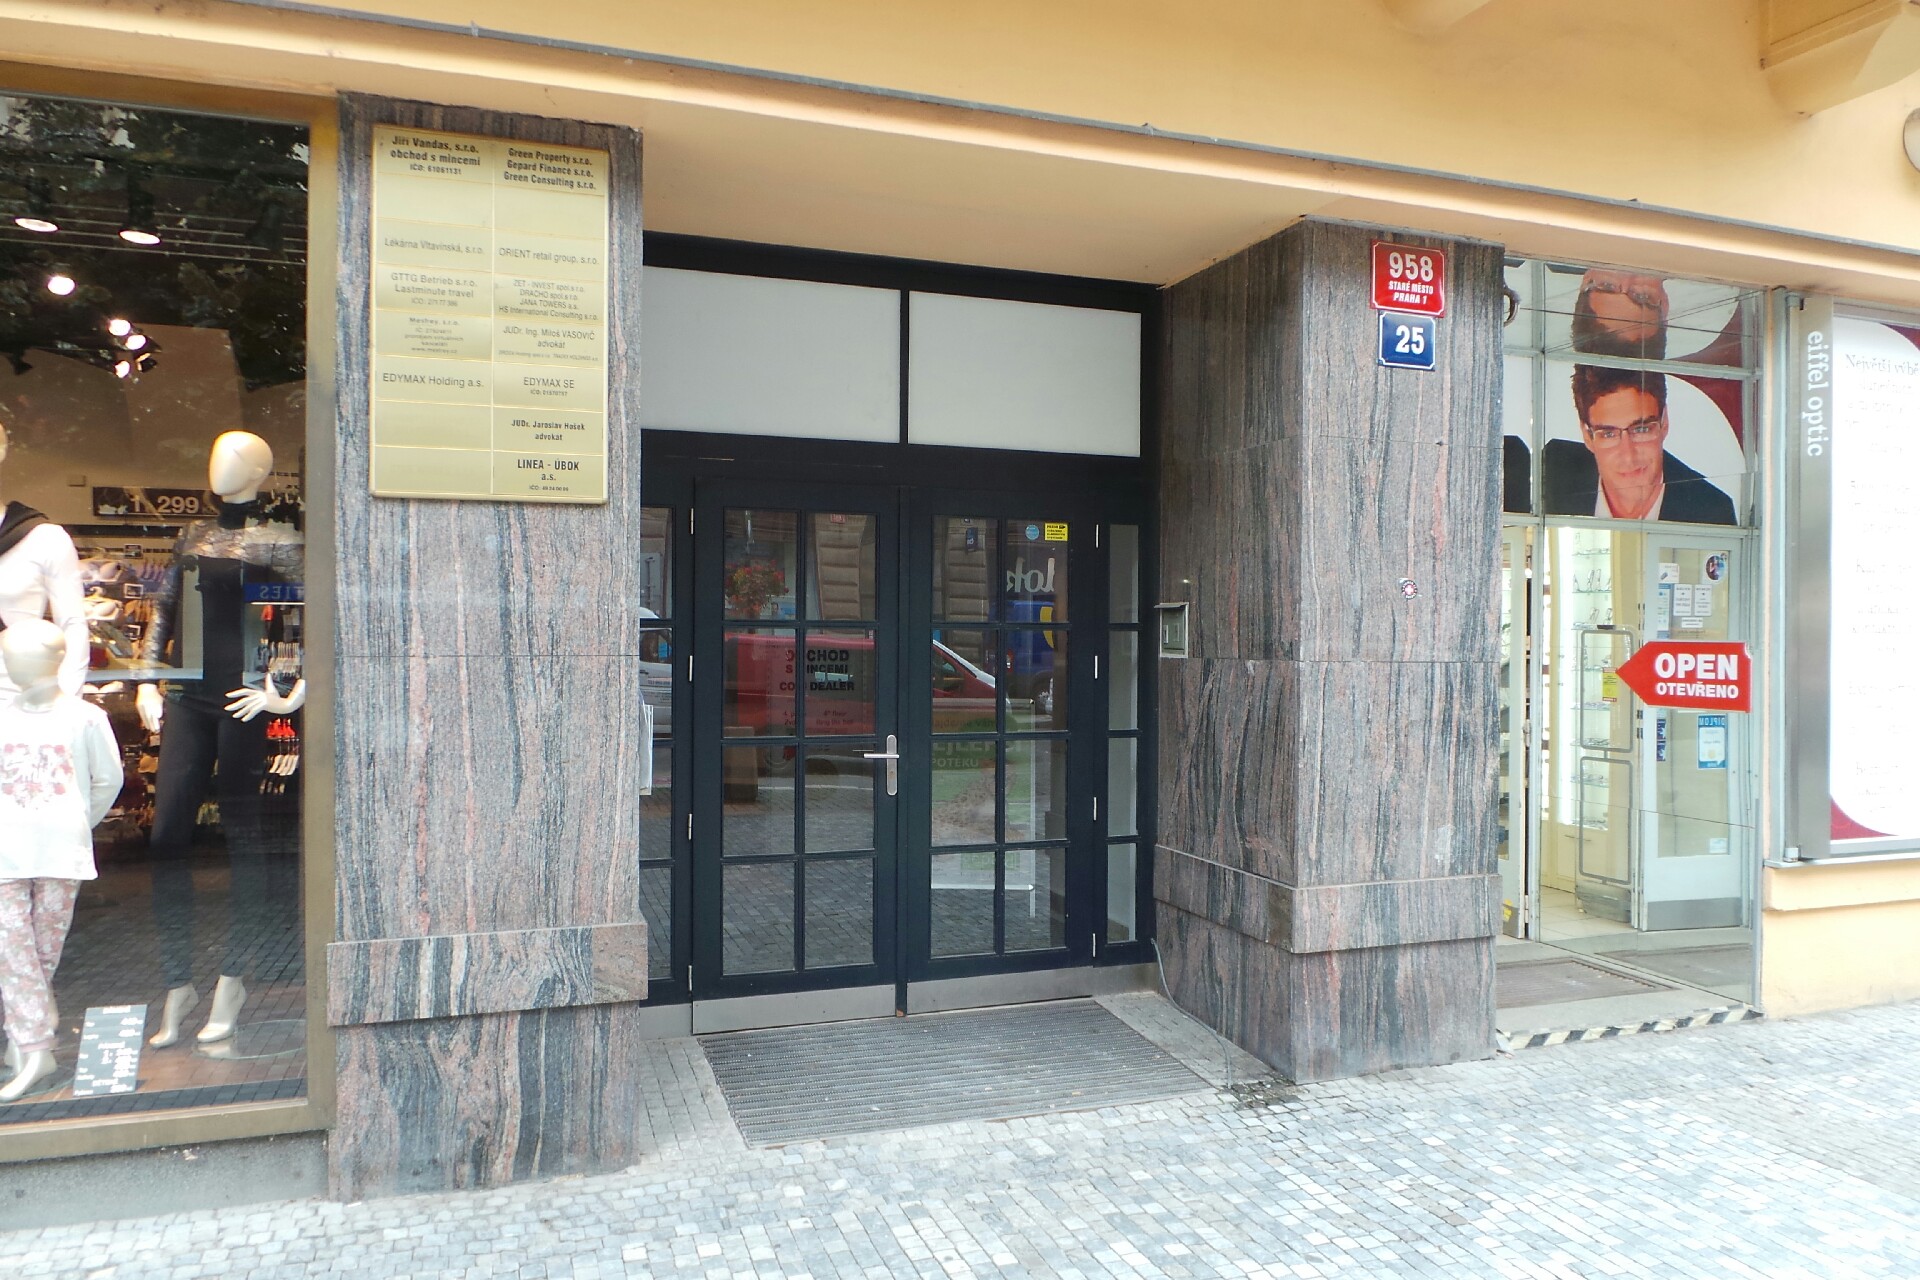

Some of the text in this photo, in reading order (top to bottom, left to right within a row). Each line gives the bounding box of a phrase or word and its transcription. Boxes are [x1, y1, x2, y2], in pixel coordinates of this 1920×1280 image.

[455, 143, 479, 153] s.r.o.
[390, 149, 427, 161] obchod
[440, 154, 480, 165] mincemi
[508, 148, 592, 165] Green Property s.r.o.
[507, 160, 594, 177] Gepard Finance s.r.o.
[504, 171, 596, 189] Green Consulting s.r.o.
[499, 248, 531, 258] ORIENT
[533, 252, 552, 260] retail
[1389, 252, 1434, 282] 958
[420, 274, 453, 285] Betrieb
[531, 281, 555, 290] INVEST
[1388, 280, 1410, 292] STARÉ
[395, 284, 474, 298] Lastminute travel
[539, 300, 567, 309] TOWERS
[1393, 292, 1427, 304] PRAHA 1
[510, 306, 548, 316] International
[550, 310, 583, 320] Consulting
[525, 327, 539, 337] Ing.
[541, 328, 560, 337] Miloš
[1395, 325, 1425, 355] 25
[382, 373, 426, 384] EDYMAX
[429, 376, 465, 388] Holding
[524, 377, 575, 388] EDYMAX SE
[1802, 330, 1829, 456] eiffel optic
[533, 421, 562, 429] Jaroslav
[517, 459, 544, 469] LINEA
[157, 496, 199, 514] 299
[806, 664, 848, 674] INCEMI
[1655, 652, 1738, 681] OPEN
[810, 682, 854, 691] DEALER
[1656, 681, 1739, 699] OTEVŘENO
